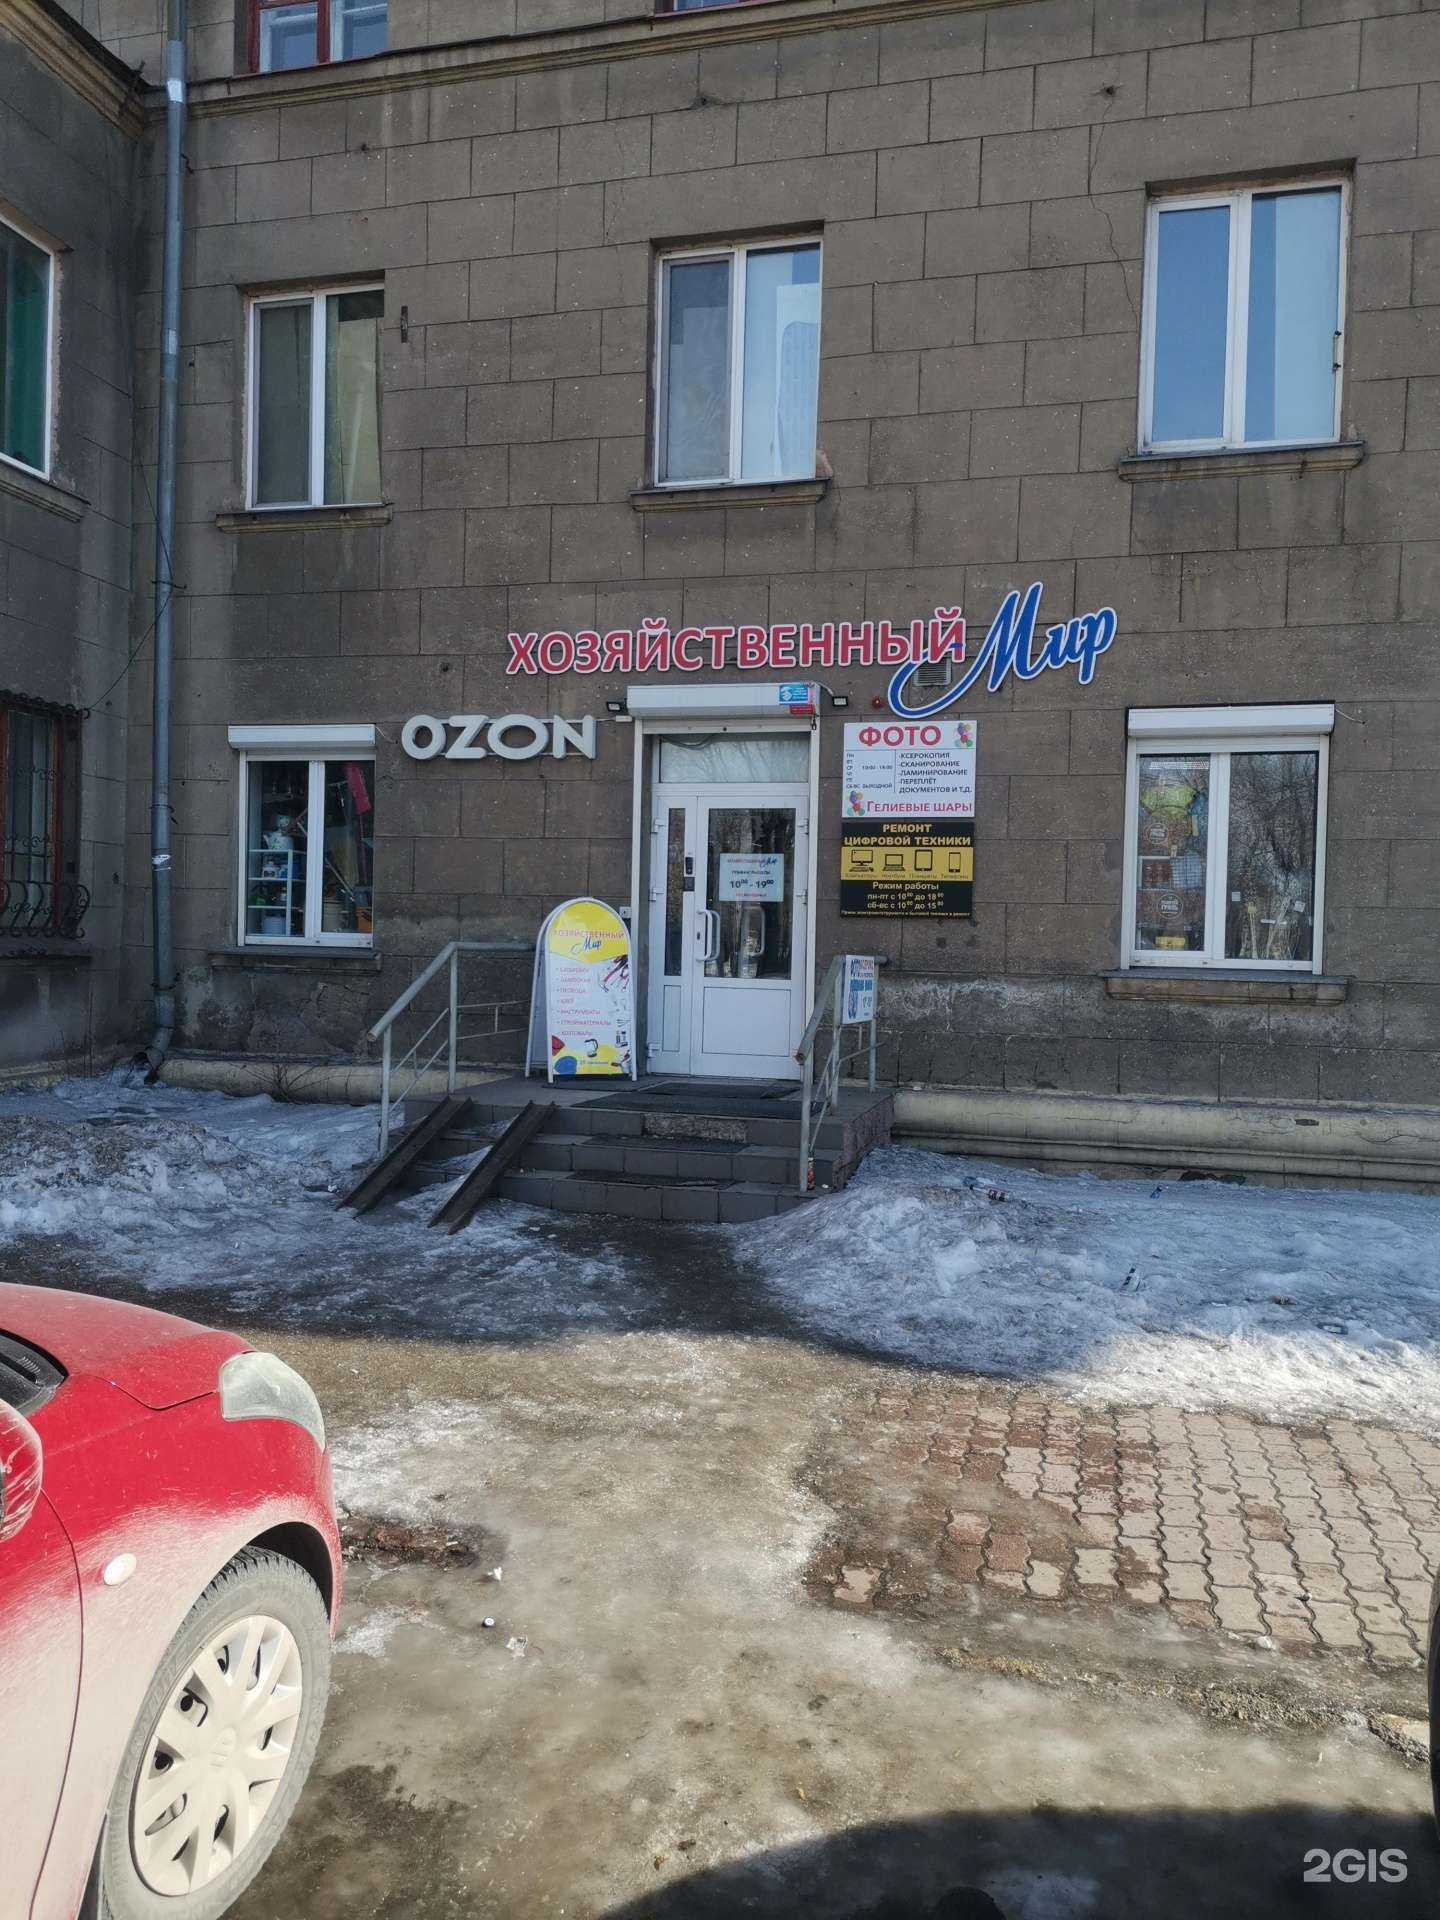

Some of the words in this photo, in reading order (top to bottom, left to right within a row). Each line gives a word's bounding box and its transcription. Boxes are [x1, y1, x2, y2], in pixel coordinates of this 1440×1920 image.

[506, 606, 967, 675] ХОЗЯЙСТВЕННЫЙ
[888, 581, 1117, 718] Мир
[401, 714, 597, 760] OZON
[858, 726, 942, 747] ФОТО
[867, 801, 930, 813] ГЕЛИЕВЫЕ
[933, 803, 972, 812] ШАРЫ
[882, 823, 932, 833] РЕМОНТ
[844, 835, 911, 847] ЦИФРОВОЙ
[914, 837, 971, 846] ТЕХНИКИ
[872, 881, 902, 890] Режим
[904, 881, 939, 891] работы
